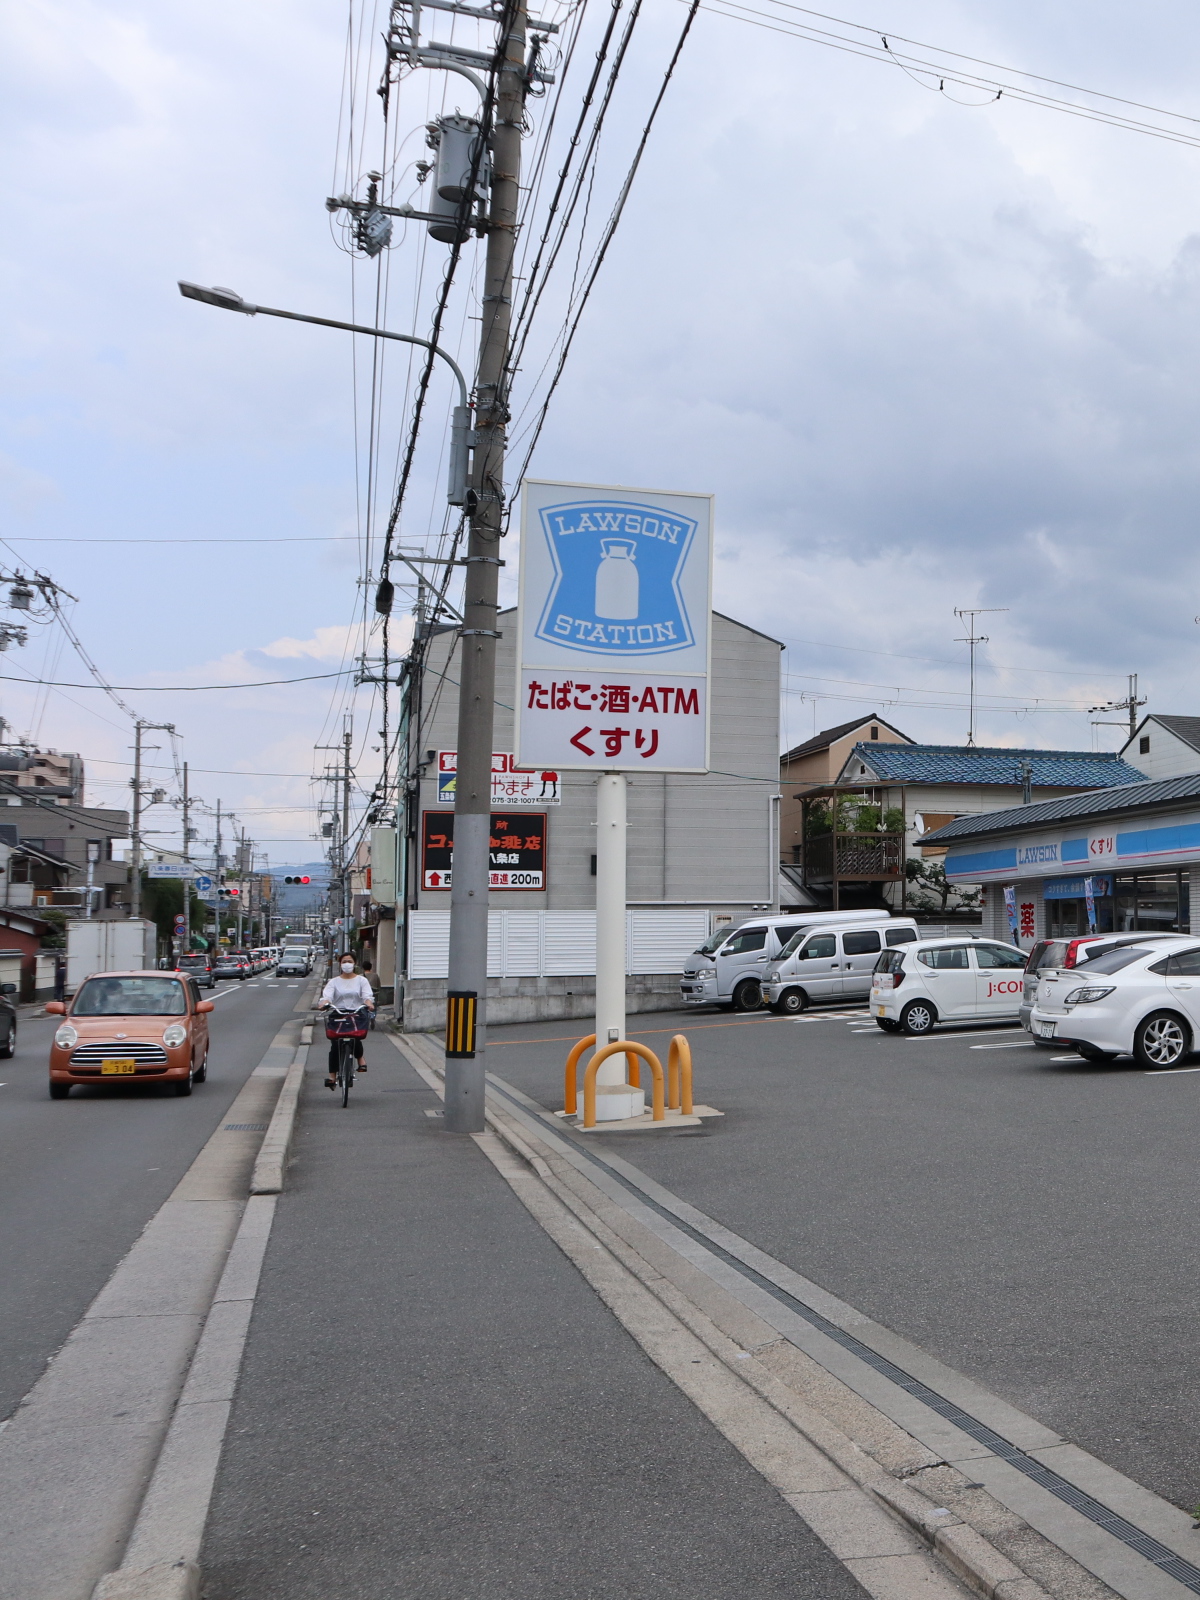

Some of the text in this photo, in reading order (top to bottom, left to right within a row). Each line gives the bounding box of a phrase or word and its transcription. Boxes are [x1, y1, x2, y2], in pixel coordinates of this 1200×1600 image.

[554, 512, 682, 545] LAWSON
[553, 614, 677, 645] STATION
[527, 680, 700, 715] たばこ・酒・ATM
[569, 725, 660, 759] くすり
[1018, 843, 1058, 865] LAWSON
[1090, 837, 1113, 855] くすり
[511, 873, 540, 885] 200m
[1020, 902, 1035, 939] 薬
